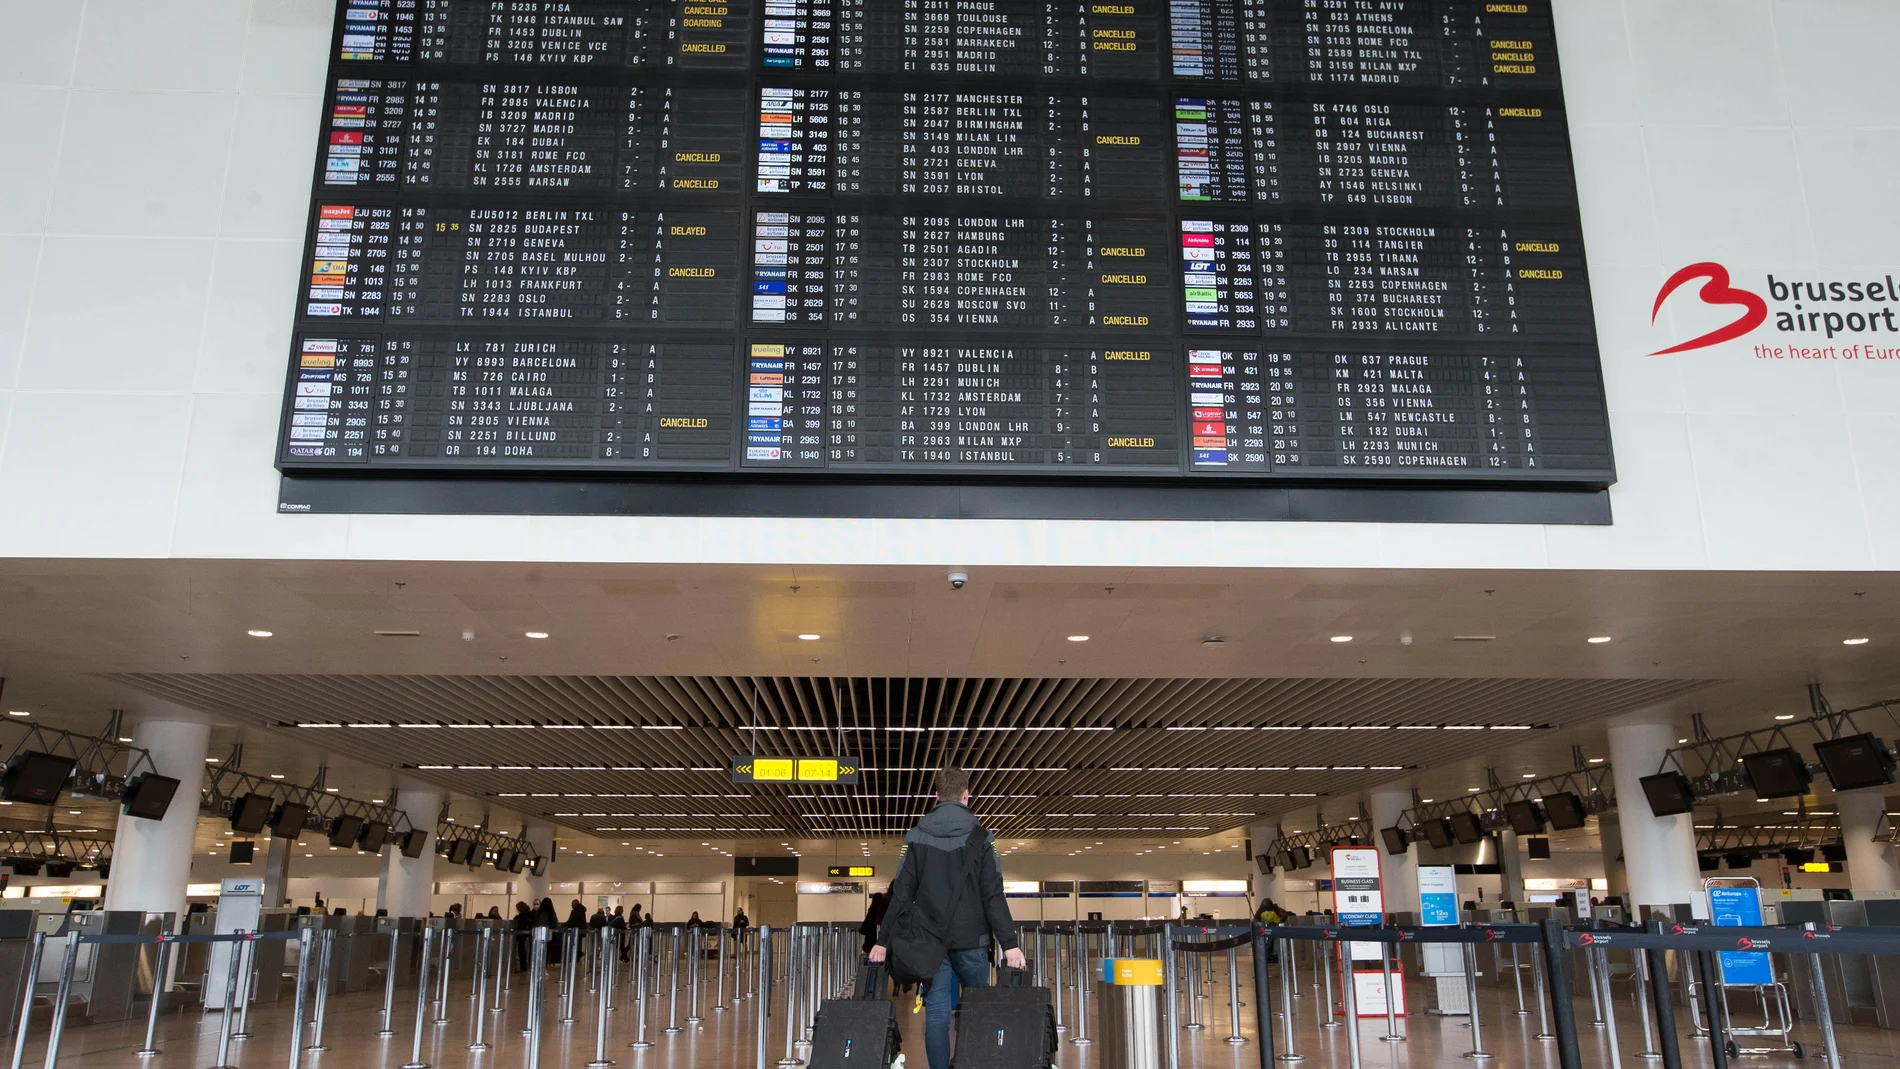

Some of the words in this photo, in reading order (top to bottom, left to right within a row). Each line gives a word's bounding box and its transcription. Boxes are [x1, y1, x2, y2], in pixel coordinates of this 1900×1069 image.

[545, 4, 570, 12] PISA
[685, 7, 727, 15] CANCELLED
[957, 2, 994, 10] PRAGUE
[1092, 6, 1134, 14] CANCELLED
[1355, 1, 1372, 9] TEL
[1380, 2, 1403, 10] AVIV
[1486, 4, 1527, 13] CANCELLED
[545, 16, 595, 25] ISTANBUL
[604, 17, 623, 25] SAW
[684, 19, 721, 27] BOARDING
[957, 14, 1007, 22] TOULOUSE
[1356, 13, 1392, 22] ATHENS
[542, 29, 581, 37] DUBLIN
[957, 26, 1021, 35] COPENHAGEN
[1093, 30, 1135, 38] CANCELLED
[1357, 25, 1413, 34] BARCELONA
[957, 39, 1014, 47] MARRAKECH
[1094, 42, 1136, 50] CANCELLED
[1390, 38, 1408, 46] FCO
[1491, 41, 1532, 49] CANCELLED
[1359, 50, 1396, 58] BERLIN
[1404, 51, 1421, 59] TXL
[1492, 53, 1534, 61] CANCELLED
[538, 86, 577, 94] LISBON
[537, 99, 589, 107] VALENCIA
[957, 95, 1022, 103] MANCHESTER
[957, 108, 995, 116] BERLIN
[1365, 105, 1389, 113] OSLO
[1499, 108, 1541, 117] CANCELLED
[534, 112, 574, 120] MADRID
[957, 120, 1022, 129] BIRMINGHAM
[1366, 118, 1391, 126] RIGA
[957, 133, 989, 141] MILAN
[997, 134, 1015, 142] LIN
[1097, 136, 1140, 144] CANCELLED
[1367, 131, 1423, 139] BUCHAREST
[958, 146, 996, 154] LONDON
[1005, 147, 1022, 155] LHR
[532, 151, 557, 159] ROME
[567, 152, 585, 160] FCO
[676, 153, 720, 162] CANCELLED
[530, 165, 591, 173] AMSTERDAM
[958, 172, 983, 180] LYON
[529, 178, 569, 186] WARSAW
[674, 180, 718, 188] CANCELLED
[1372, 182, 1421, 190] HELSINKI
[957, 185, 1002, 194] BRISTOL
[1374, 195, 1412, 203] LISBON
[526, 211, 566, 220] BERLIN
[576, 212, 593, 220] TXL
[958, 218, 997, 227] LONDON
[1006, 219, 1024, 227] LHR
[525, 225, 579, 234] BUDAPEST
[671, 227, 706, 235] DELAYED
[1377, 227, 1435, 236] STOCKHOLM
[958, 232, 1004, 240] HAMBURG
[524, 239, 564, 247] GENEVA
[1378, 241, 1423, 249] TANGIER
[1516, 243, 1559, 252] CANCELLED
[958, 245, 997, 254] AGADIR
[1101, 248, 1145, 256] CANCELLED
[522, 252, 555, 261] BASEL
[564, 253, 605, 262] MULHOU
[1379, 254, 1418, 262] TIRANA
[958, 259, 1018, 268] STOCKHOLM
[1190, 262, 1210, 270] LOT
[521, 266, 548, 275] KYIV
[557, 267, 576, 275] KBP
[669, 268, 714, 277] CANCELLED
[1380, 267, 1419, 276] WARSAW
[1519, 270, 1562, 279] CANCELLED
[958, 273, 983, 281] ROME
[993, 273, 1011, 282] FCO
[1102, 275, 1146, 283] CANCELLED
[521, 280, 582, 289] FRANKFURT
[1382, 281, 1447, 290] COPENHAGEN
[1767, 274, 1900, 301] brussel
[958, 286, 1025, 295] COPENHAGEN
[519, 294, 545, 303] OSLO
[1383, 294, 1441, 303] BUCHAREST
[958, 300, 998, 309] MOSCOW
[1007, 301, 1025, 309] SVO
[519, 308, 572, 317] ISTANBUL
[958, 315, 998, 323] VIENNA
[1104, 316, 1148, 325] CANCELLED
[1776, 304, 1899, 339] airport
[1386, 322, 1437, 331] ALICANTE
[515, 344, 555, 352] ZURICH
[753, 346, 781, 354] vueling
[1754, 344, 1784, 359] the
[1789, 344, 1837, 360] heart
[1842, 345, 1859, 360] of
[958, 350, 1013, 358] VALENCIA
[1105, 351, 1150, 360] CANCELLED
[303, 358, 331, 367] vueling
[513, 358, 575, 367] BARCELONA
[1389, 356, 1428, 365] PRAGUE
[958, 364, 999, 372] DUBLIN
[512, 372, 546, 381] CAIRO
[1390, 370, 1423, 379] MALTA
[958, 378, 999, 387] MUNICH
[510, 387, 552, 396] MALAGA
[1392, 384, 1431, 393] MALAGA
[959, 393, 1020, 401] AMSTERDAM
[510, 402, 572, 411] LJUBLJANA
[508, 417, 549, 425] VIENNA
[661, 418, 707, 427] CANCELLED
[1395, 413, 1454, 422] NEWCASTLE
[959, 422, 999, 431] LONDON
[1009, 423, 1028, 431] LHR
[507, 431, 556, 440] BILLUND
[959, 437, 993, 445] MILAN
[1002, 437, 1021, 446] MXP
[1108, 438, 1154, 447] CANCELLED
[1397, 441, 1437, 450] MUNICH
[505, 446, 532, 455] DOHA
[961, 451, 1014, 460] ISTANBUL
[1399, 456, 1466, 465] COPENHAGEN
[759, 768, 787, 778] 01-06
[804, 768, 831, 778] 07-14
